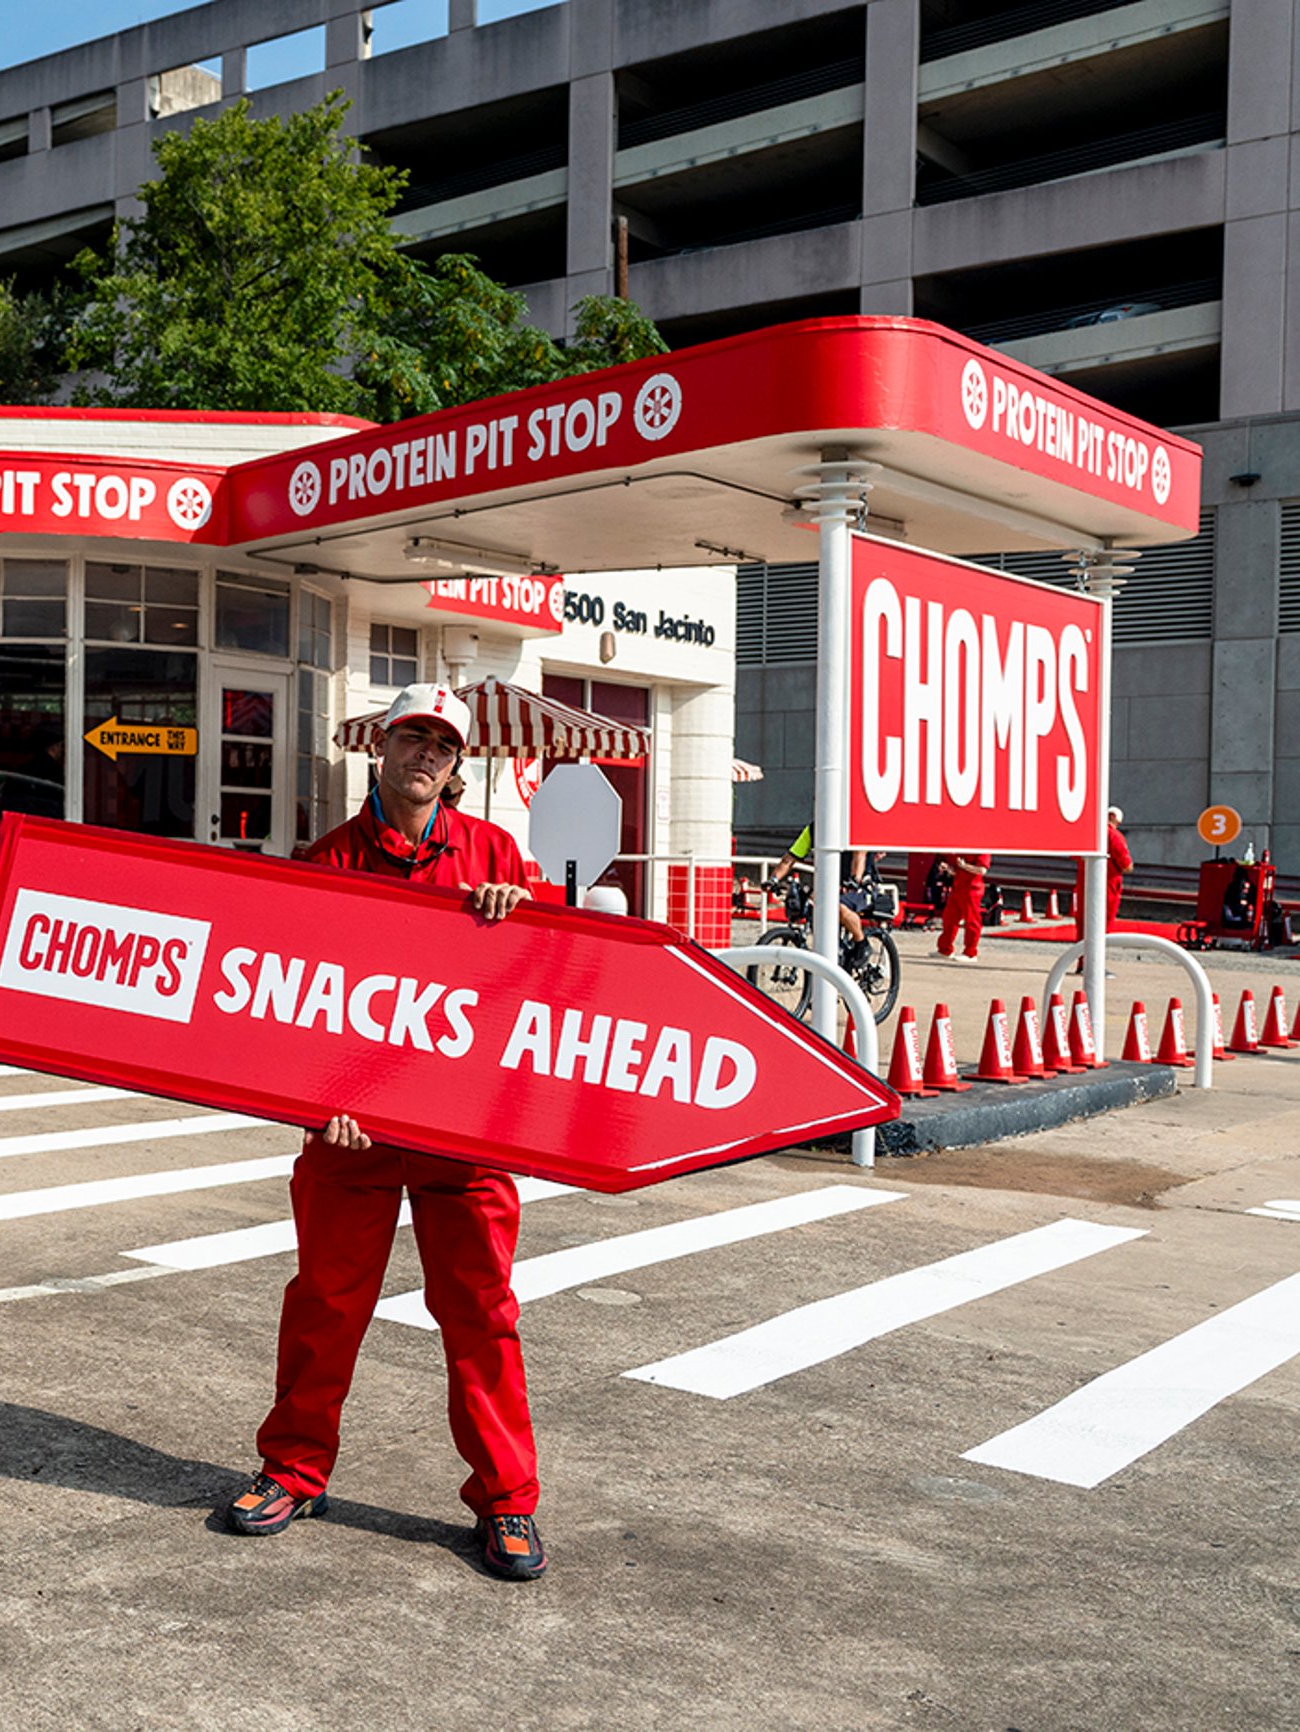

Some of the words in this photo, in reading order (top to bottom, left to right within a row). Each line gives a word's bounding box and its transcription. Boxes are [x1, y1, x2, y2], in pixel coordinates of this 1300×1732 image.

[329, 431, 456, 504] PROTEIN
[465, 416, 518, 475] PIT
[528, 392, 622, 460] STOP
[992, 376, 1074, 464] PROTEIN
[1077, 416, 1104, 476] PIT
[1107, 431, 1149, 491] STOP
[52, 472, 156, 520] STOP
[501, 576, 546, 614] STOP
[564, 590, 604, 627] 500
[614, 601, 647, 633] San
[654, 610, 715, 647] Jacinto
[863, 578, 1089, 822] CHOMPS
[100, 731, 161, 748] ENTRANCE
[167, 730, 186, 741] THIS
[167, 741, 186, 750] WAY
[1212, 814, 1226, 835] 3
[19, 914, 188, 996] CHOMPS
[214, 948, 478, 1057] SNACKS
[500, 1000, 756, 1108] AHEAD
